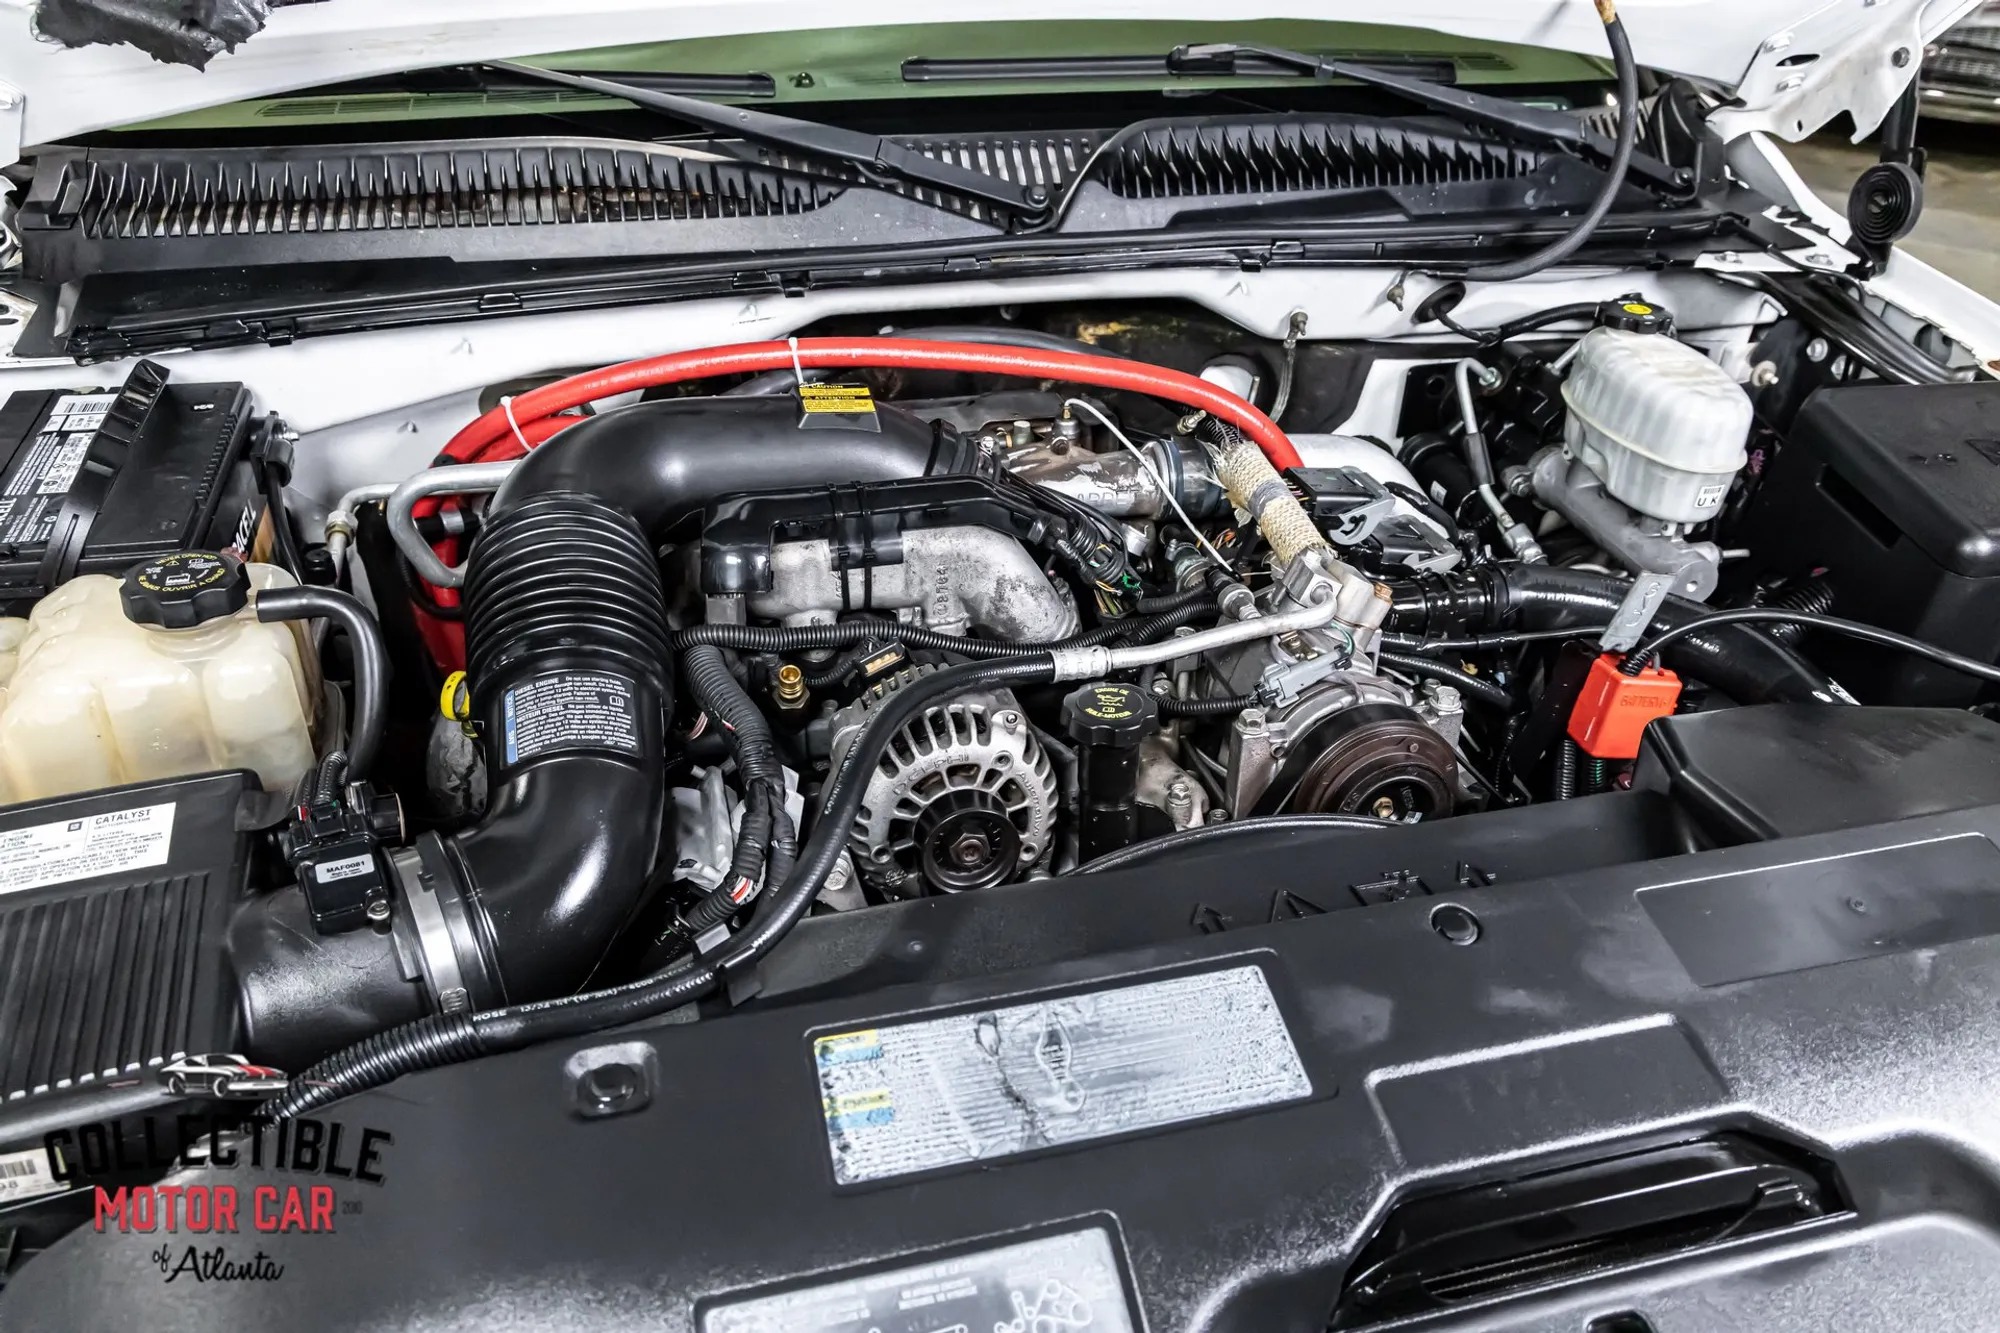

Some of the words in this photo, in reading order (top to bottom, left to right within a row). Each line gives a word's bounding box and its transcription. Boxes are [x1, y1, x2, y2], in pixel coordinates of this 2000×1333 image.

[162, 584, 198, 592] OUVRIR
[514, 684, 535, 696] DIESEL
[536, 677, 559, 688] ENGINE
[517, 710, 541, 723] MOTEUR
[542, 705, 564, 714] DIESEL
[95, 808, 152, 826] CATALYST
[326, 860, 365, 873] MAF0081
[472, 1009, 508, 1022] HOSE
